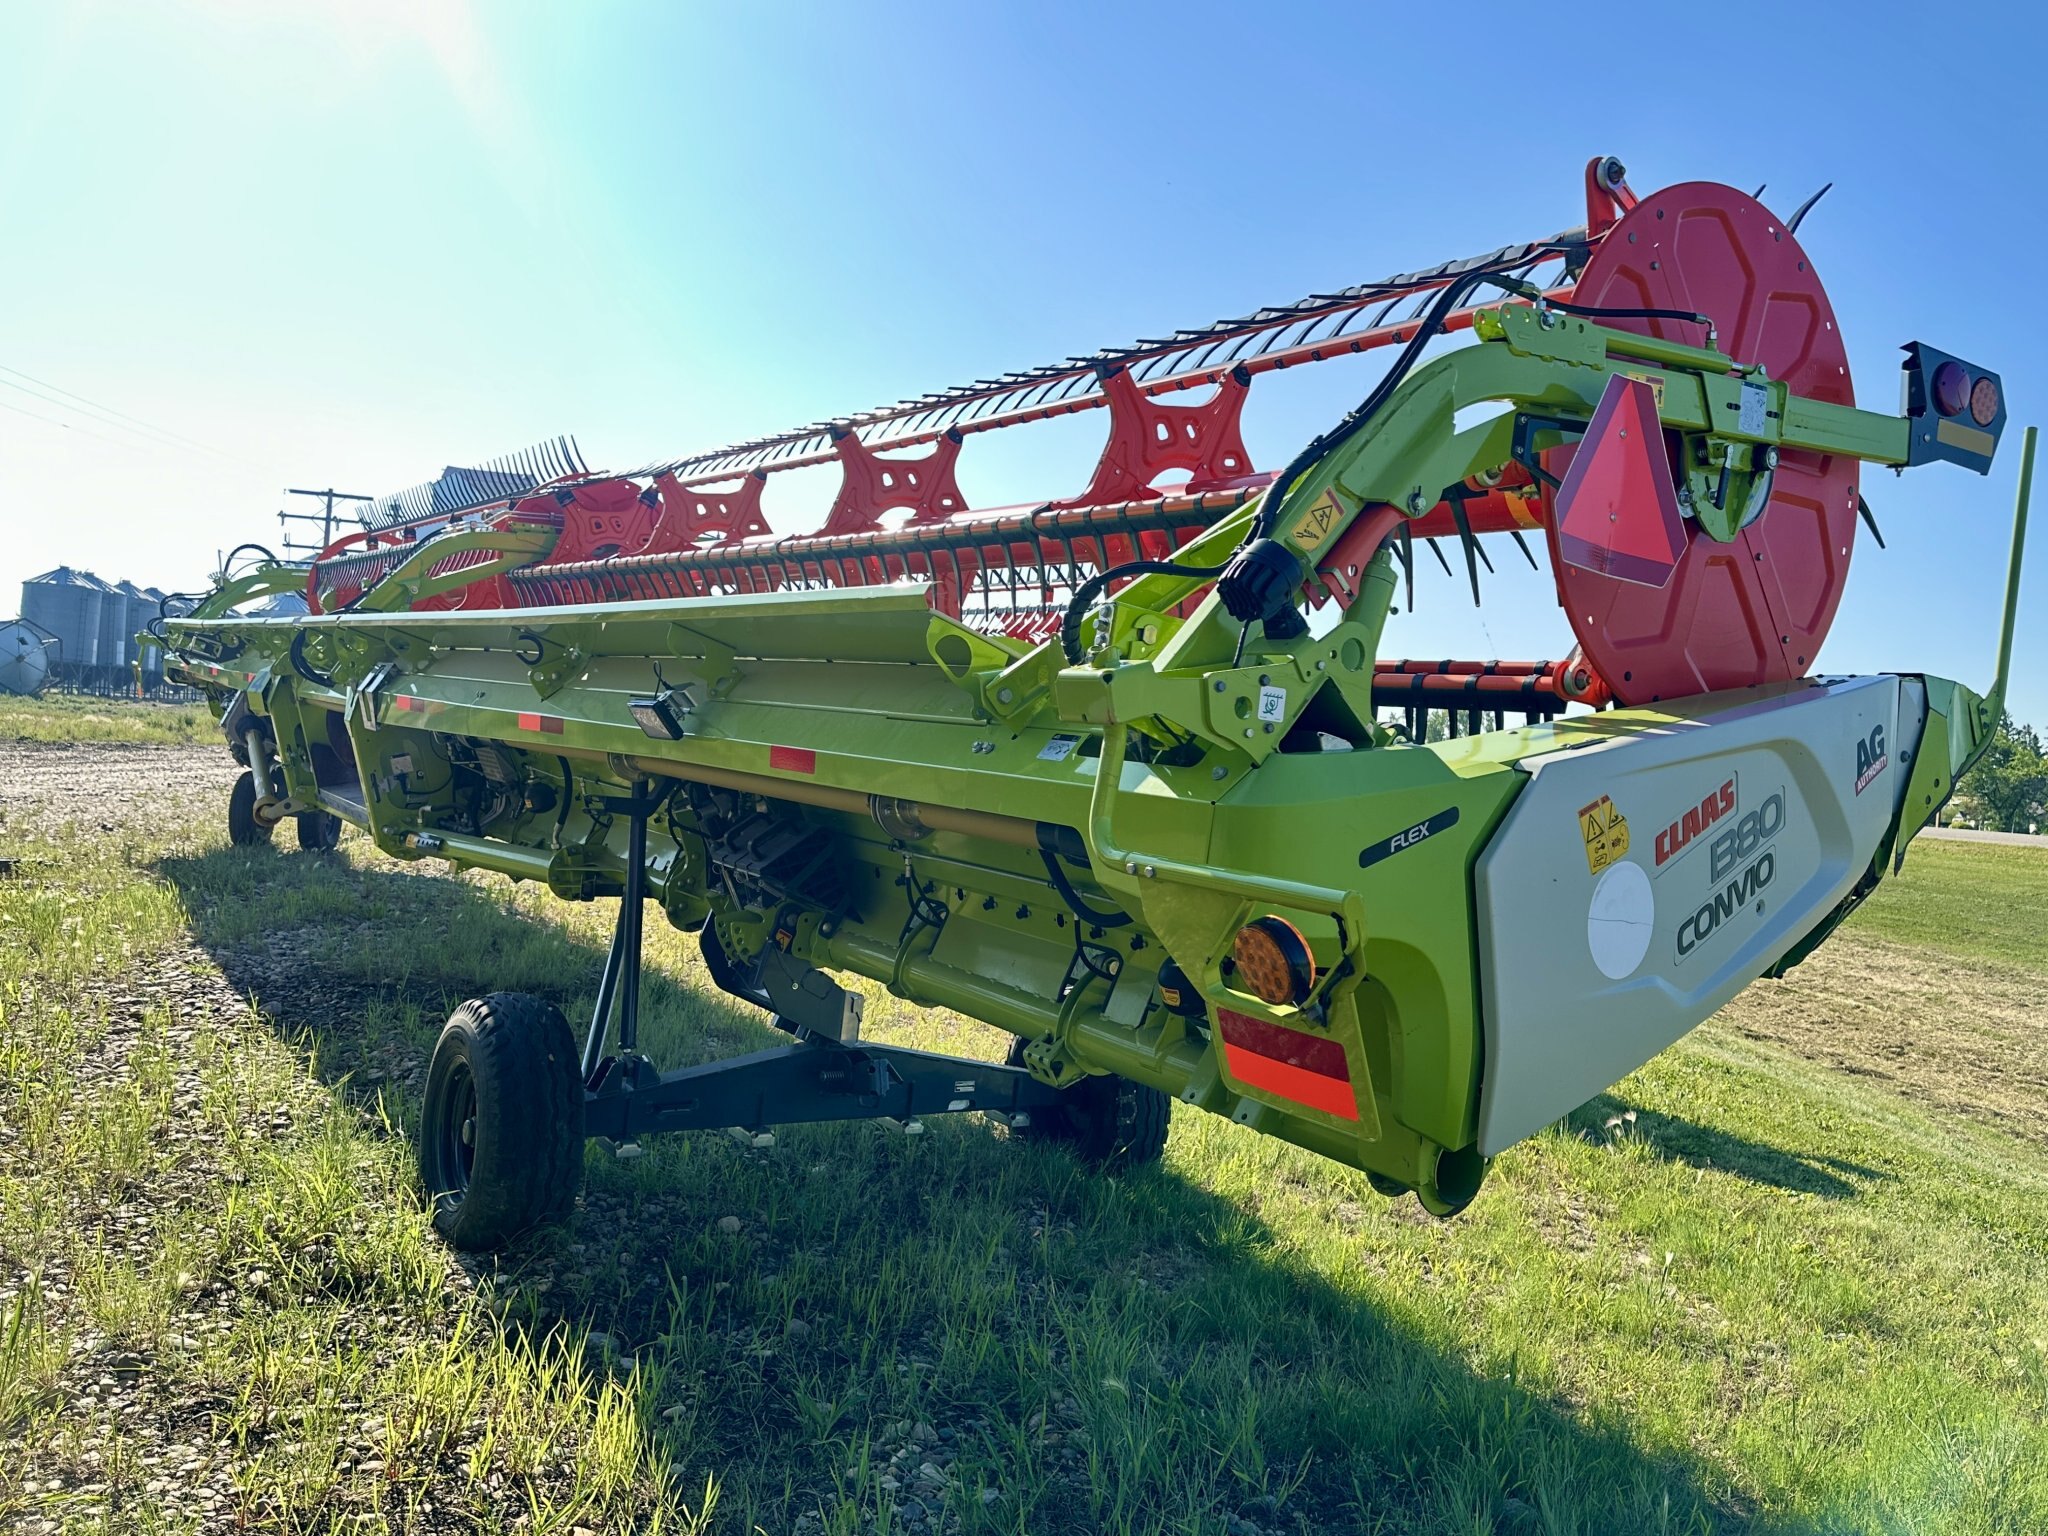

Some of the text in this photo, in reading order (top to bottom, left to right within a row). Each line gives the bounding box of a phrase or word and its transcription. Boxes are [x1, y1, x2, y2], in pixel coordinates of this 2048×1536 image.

[1856, 754, 1888, 793] AUTHORITY
[1857, 724, 1885, 780] AG
[1390, 821, 1430, 853] FLEX
[1655, 778, 1735, 867] CLAAS
[1676, 852, 1774, 956] CONVIO
